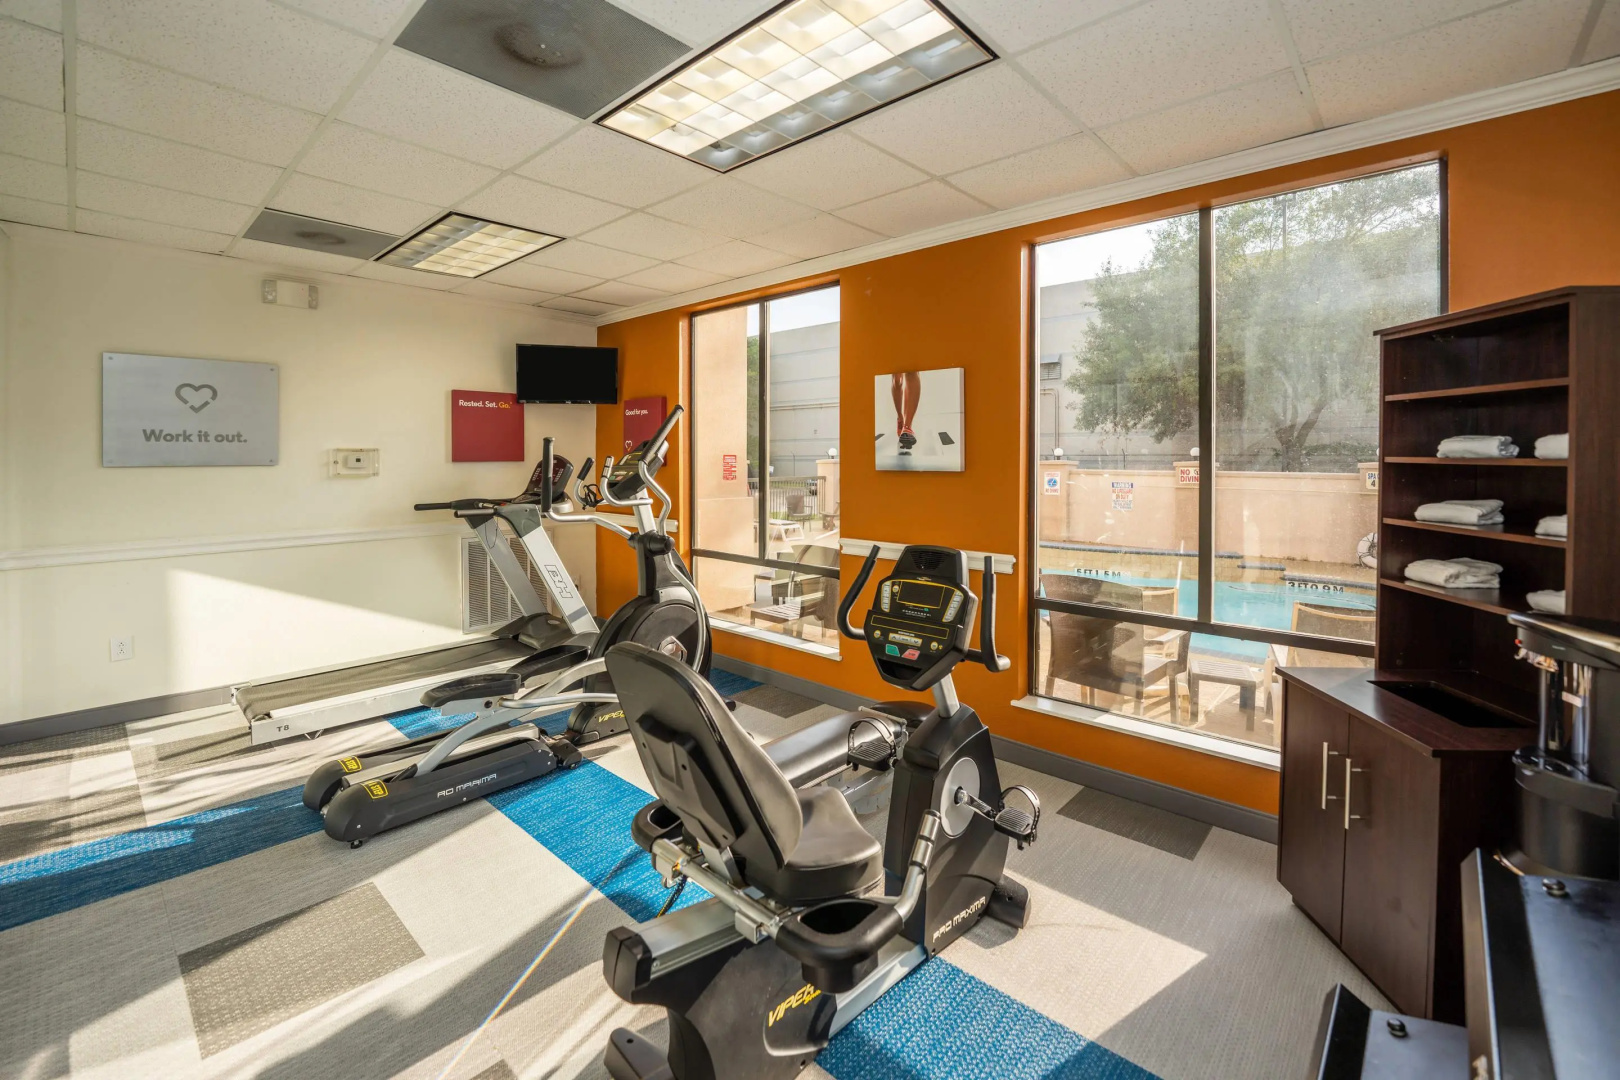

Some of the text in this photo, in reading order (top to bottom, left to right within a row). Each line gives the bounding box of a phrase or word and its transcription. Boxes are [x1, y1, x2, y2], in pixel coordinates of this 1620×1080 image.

[459, 399, 484, 407] Rested.
[485, 400, 498, 408] Set.
[142, 428, 248, 444] Work it out.
[1180, 468, 1191, 476] NO
[1180, 475, 1199, 483] DIVIN
[1370, 479, 1376, 487] 4
[276, 724, 290, 732] T8
[932, 920, 952, 943] PRO
